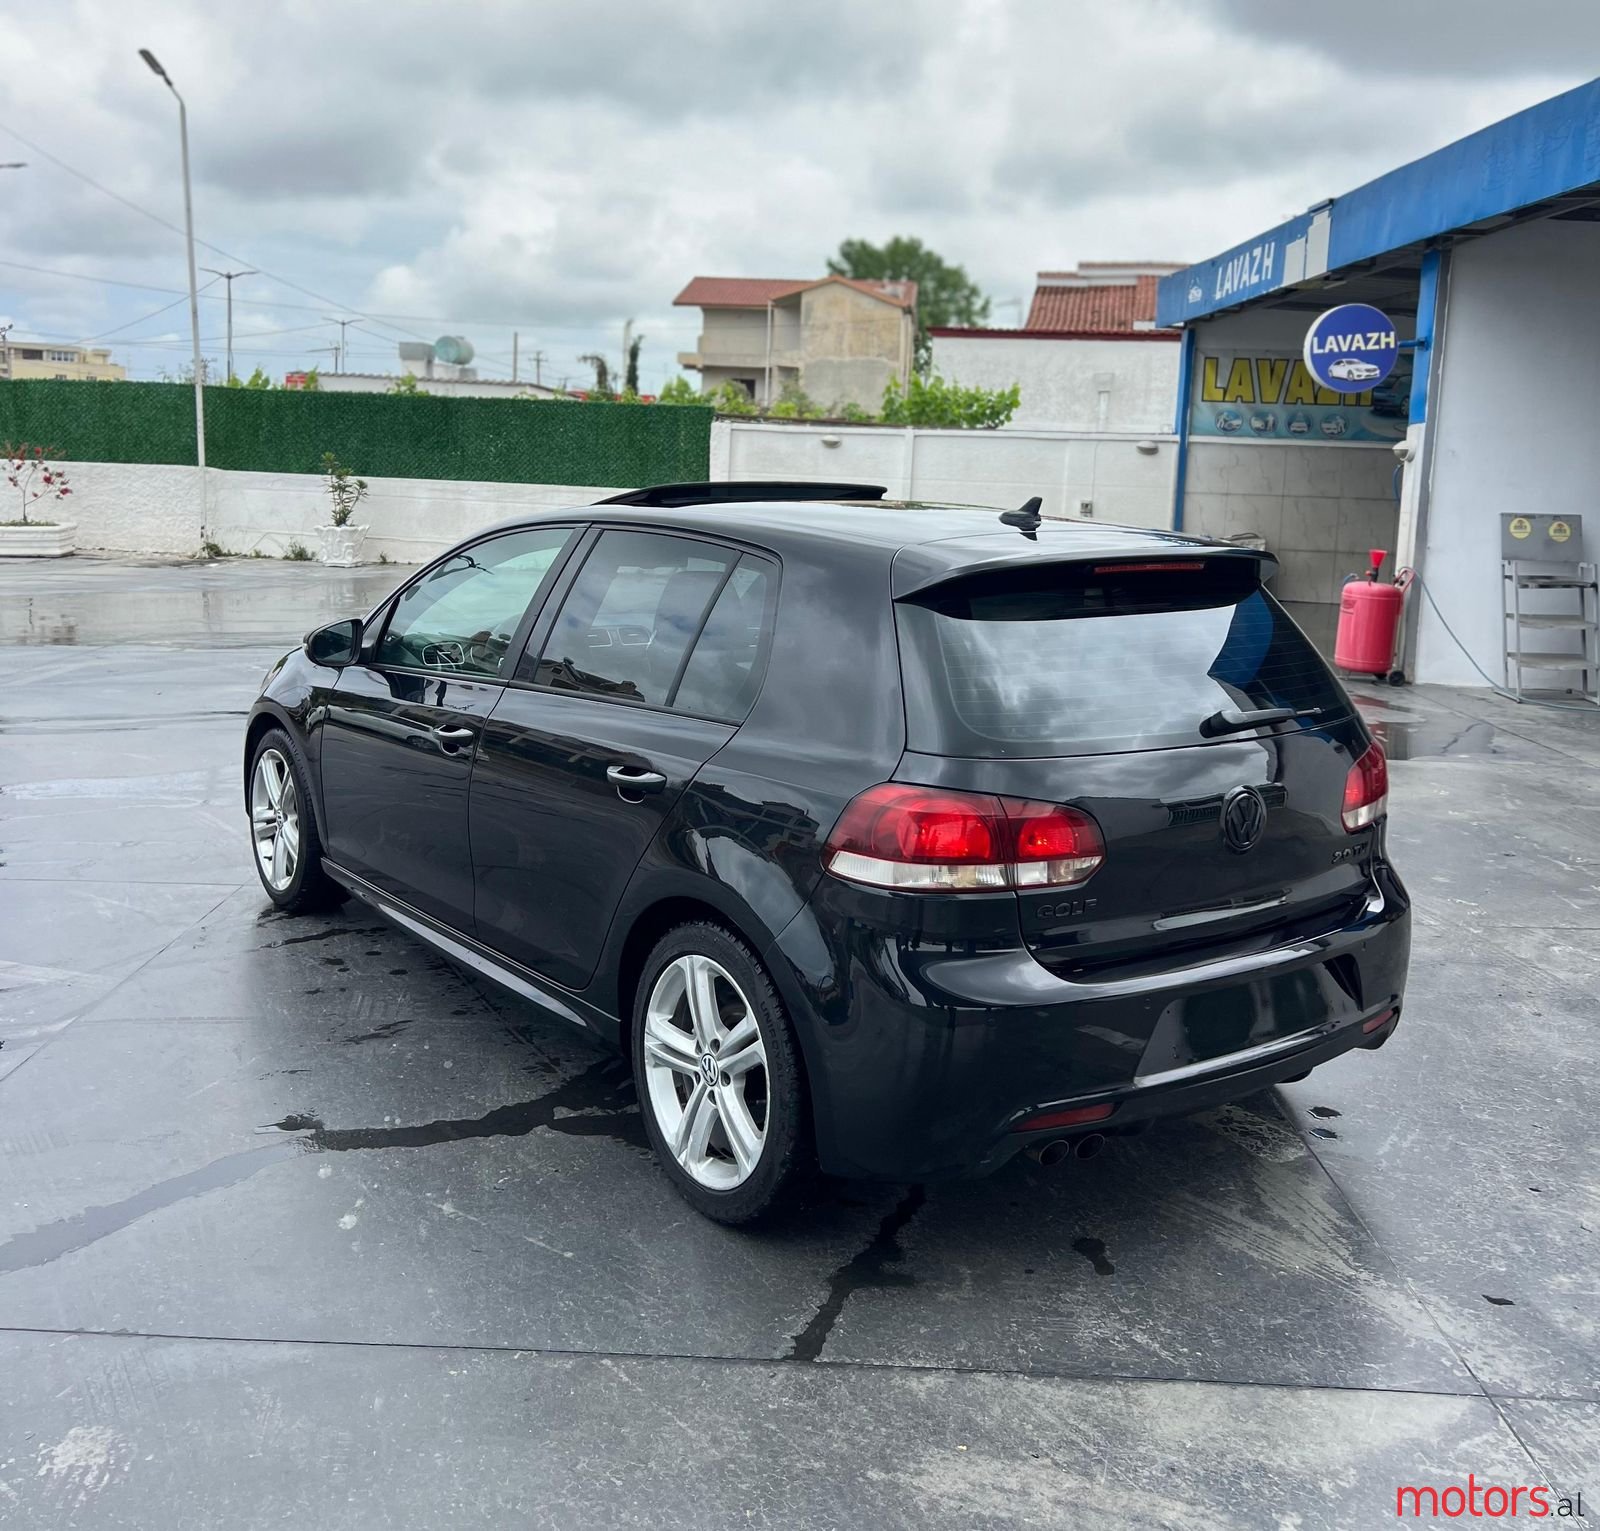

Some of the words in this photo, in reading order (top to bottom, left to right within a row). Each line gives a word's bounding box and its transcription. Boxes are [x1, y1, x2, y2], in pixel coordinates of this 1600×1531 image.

[1214, 242, 1275, 300] LAVAZH
[1312, 331, 1396, 354] LAVAZH
[1201, 357, 1374, 407] LAVA
[1036, 898, 1098, 919] GOLF
